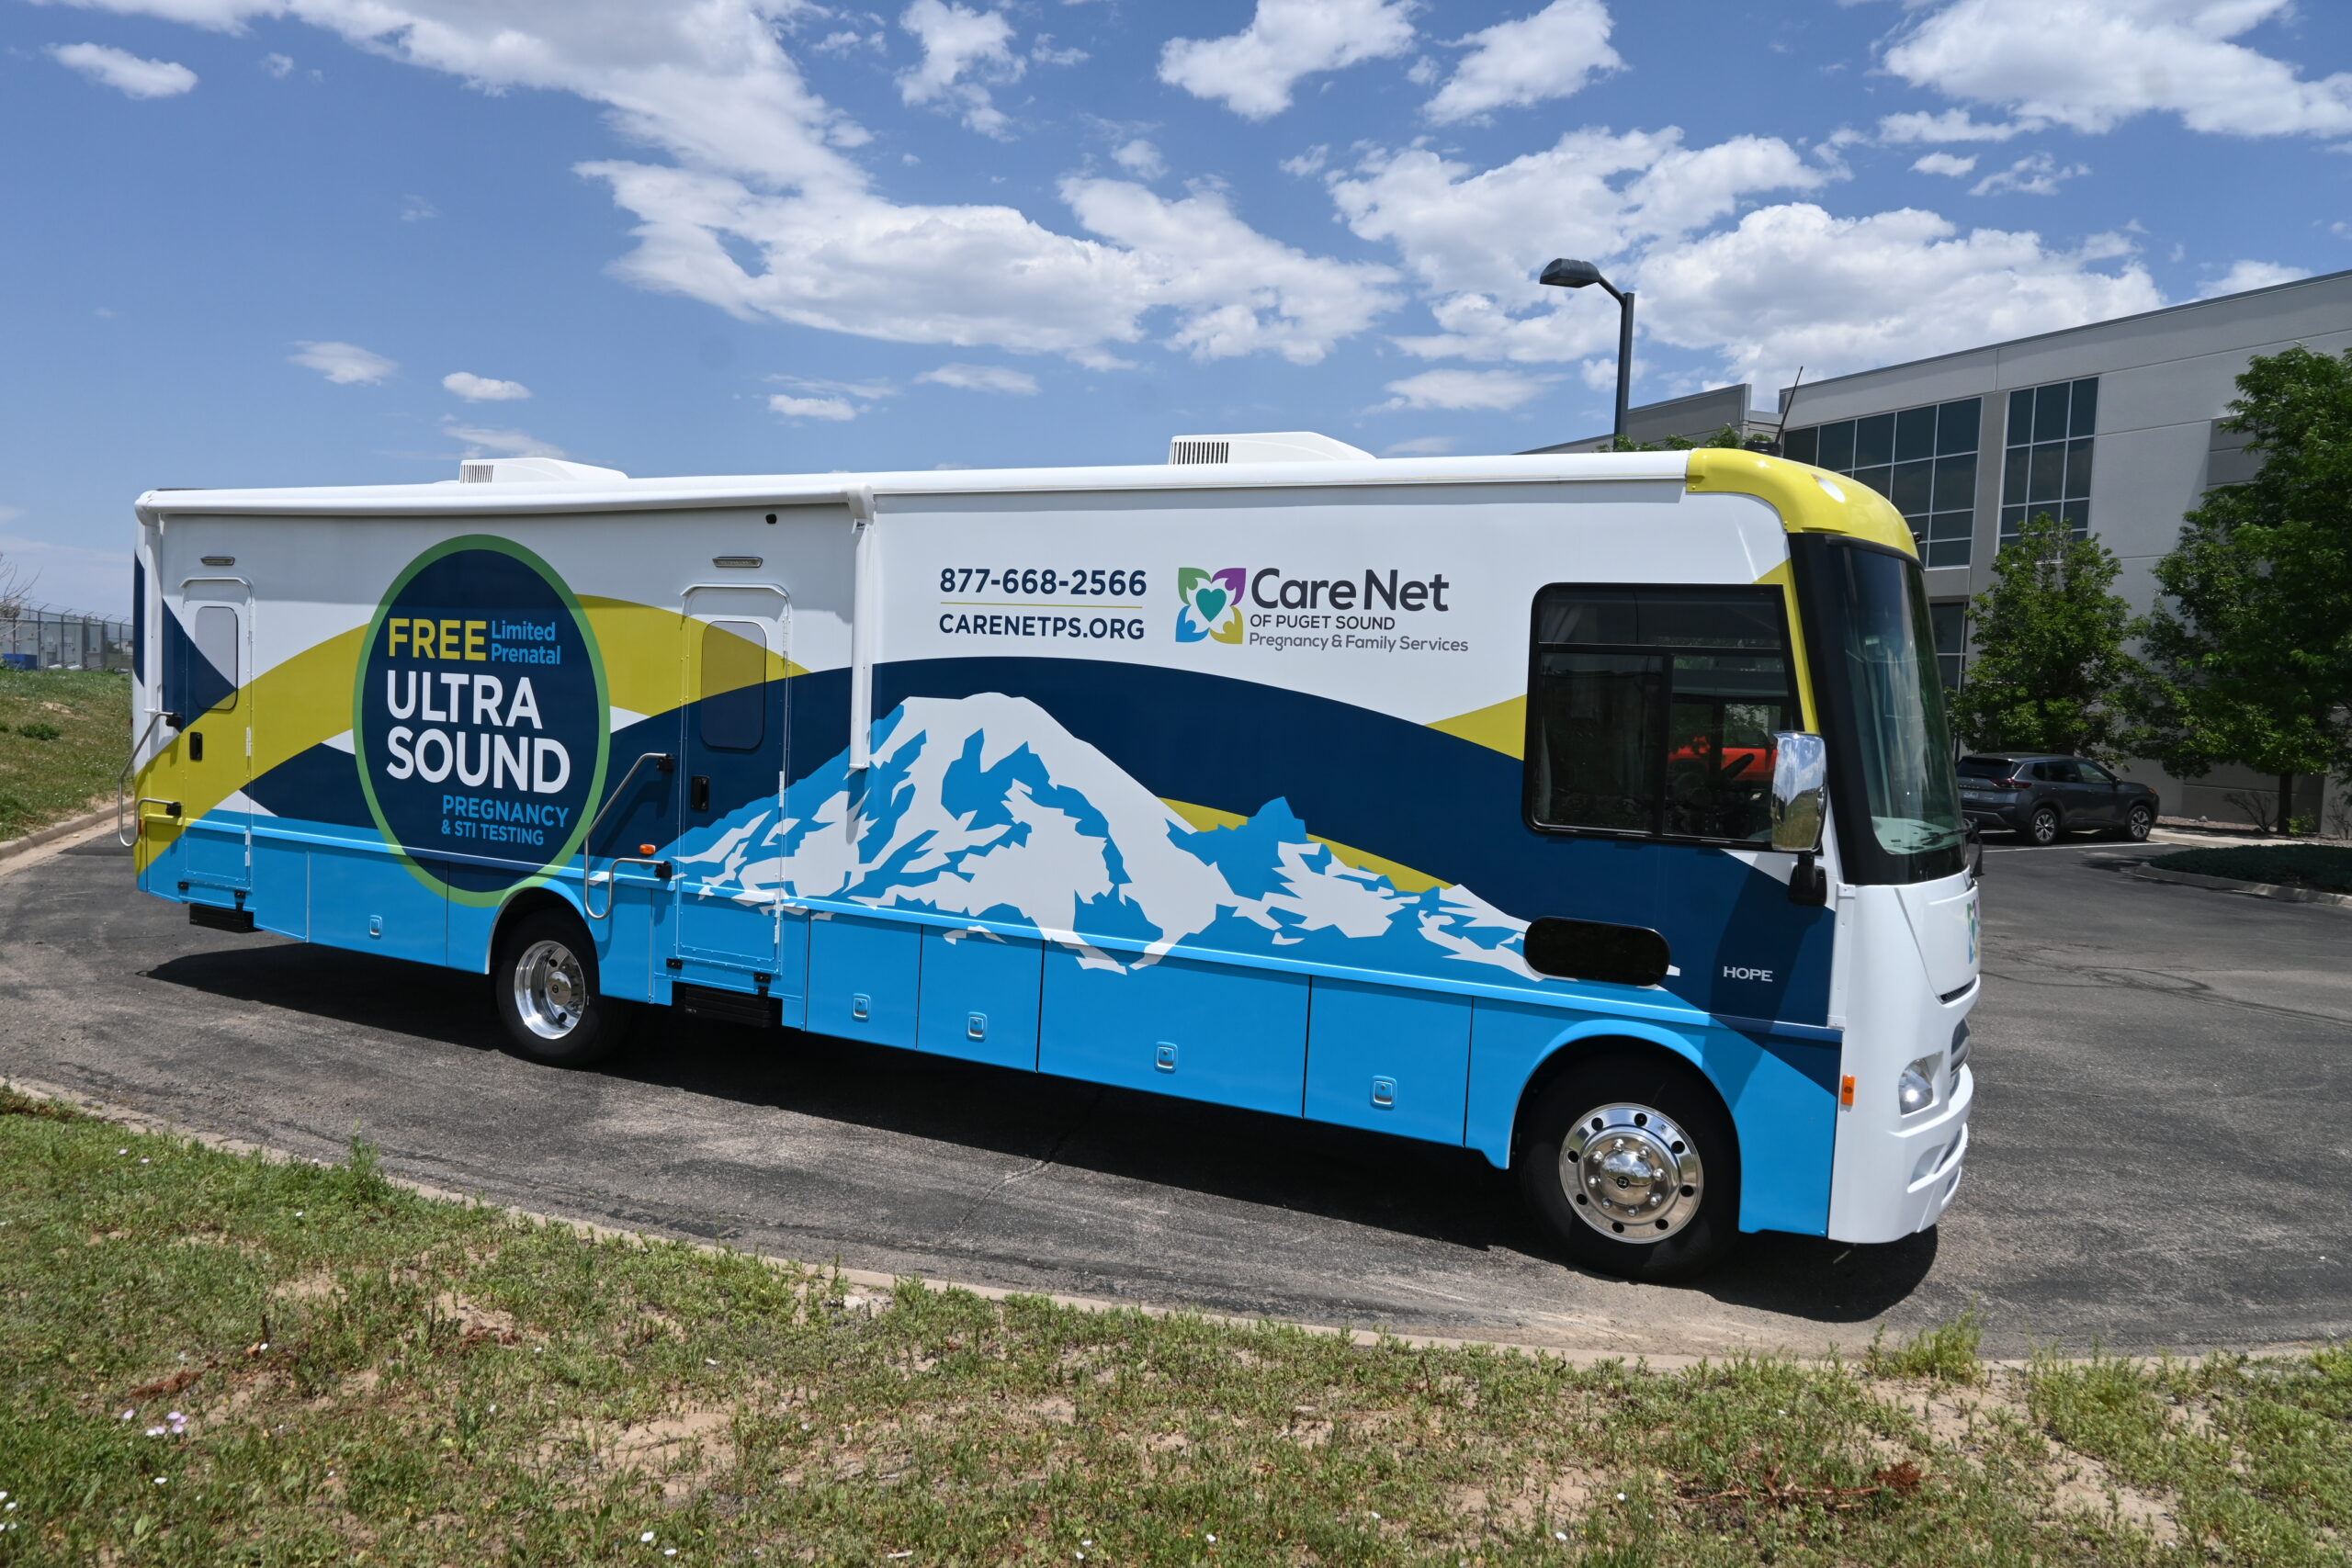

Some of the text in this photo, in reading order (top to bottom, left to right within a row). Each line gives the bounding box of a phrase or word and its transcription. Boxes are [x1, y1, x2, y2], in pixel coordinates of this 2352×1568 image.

[940, 568, 1147, 596] 877-668-2566
[1251, 568, 1450, 612] Care Net
[491, 620, 556, 642] Limited
[939, 613, 1145, 639] CARENETPS.ORG
[1250, 614, 1396, 631] OF PUGET SOUND
[388, 617, 487, 661] FREE
[1250, 632, 1469, 653] Pregnancy & Family Services
[491, 643, 561, 665] Prenatal
[387, 670, 544, 730] ULTRA
[386, 726, 571, 795] SOUND
[442, 795, 570, 828] PREGNANCY
[441, 819, 545, 846] & STI TESTING
[1724, 965, 1773, 982] HOPE
